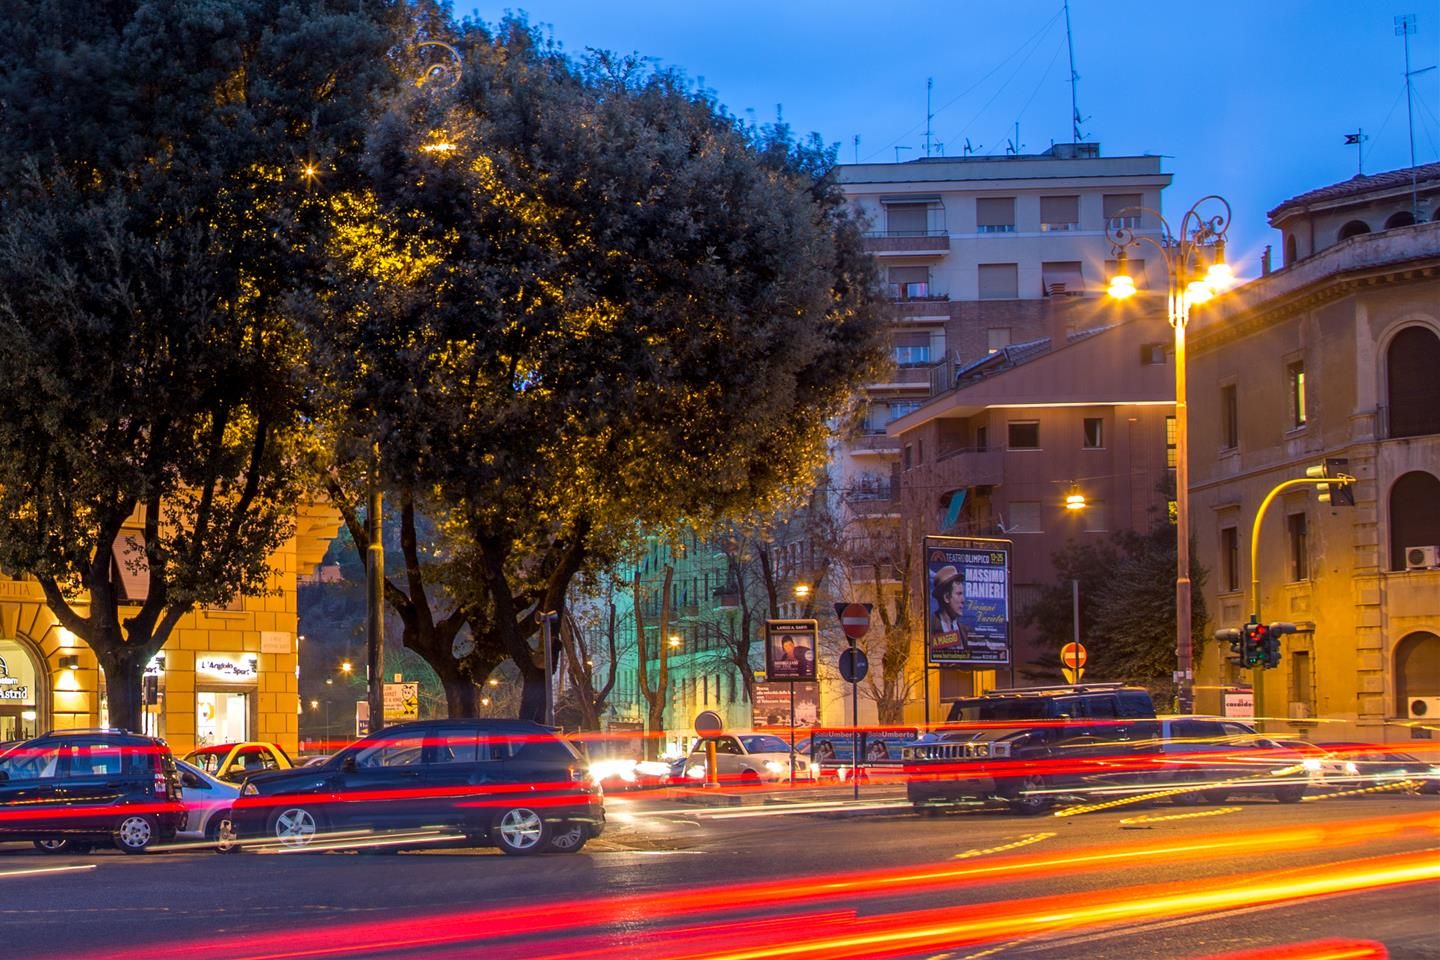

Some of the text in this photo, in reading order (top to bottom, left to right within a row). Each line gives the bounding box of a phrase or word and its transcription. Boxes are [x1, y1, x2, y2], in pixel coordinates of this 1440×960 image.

[965, 568, 1005, 583] MASSIMO
[965, 582, 1005, 598] RANIERI
[233, 666, 250, 676] Sport
